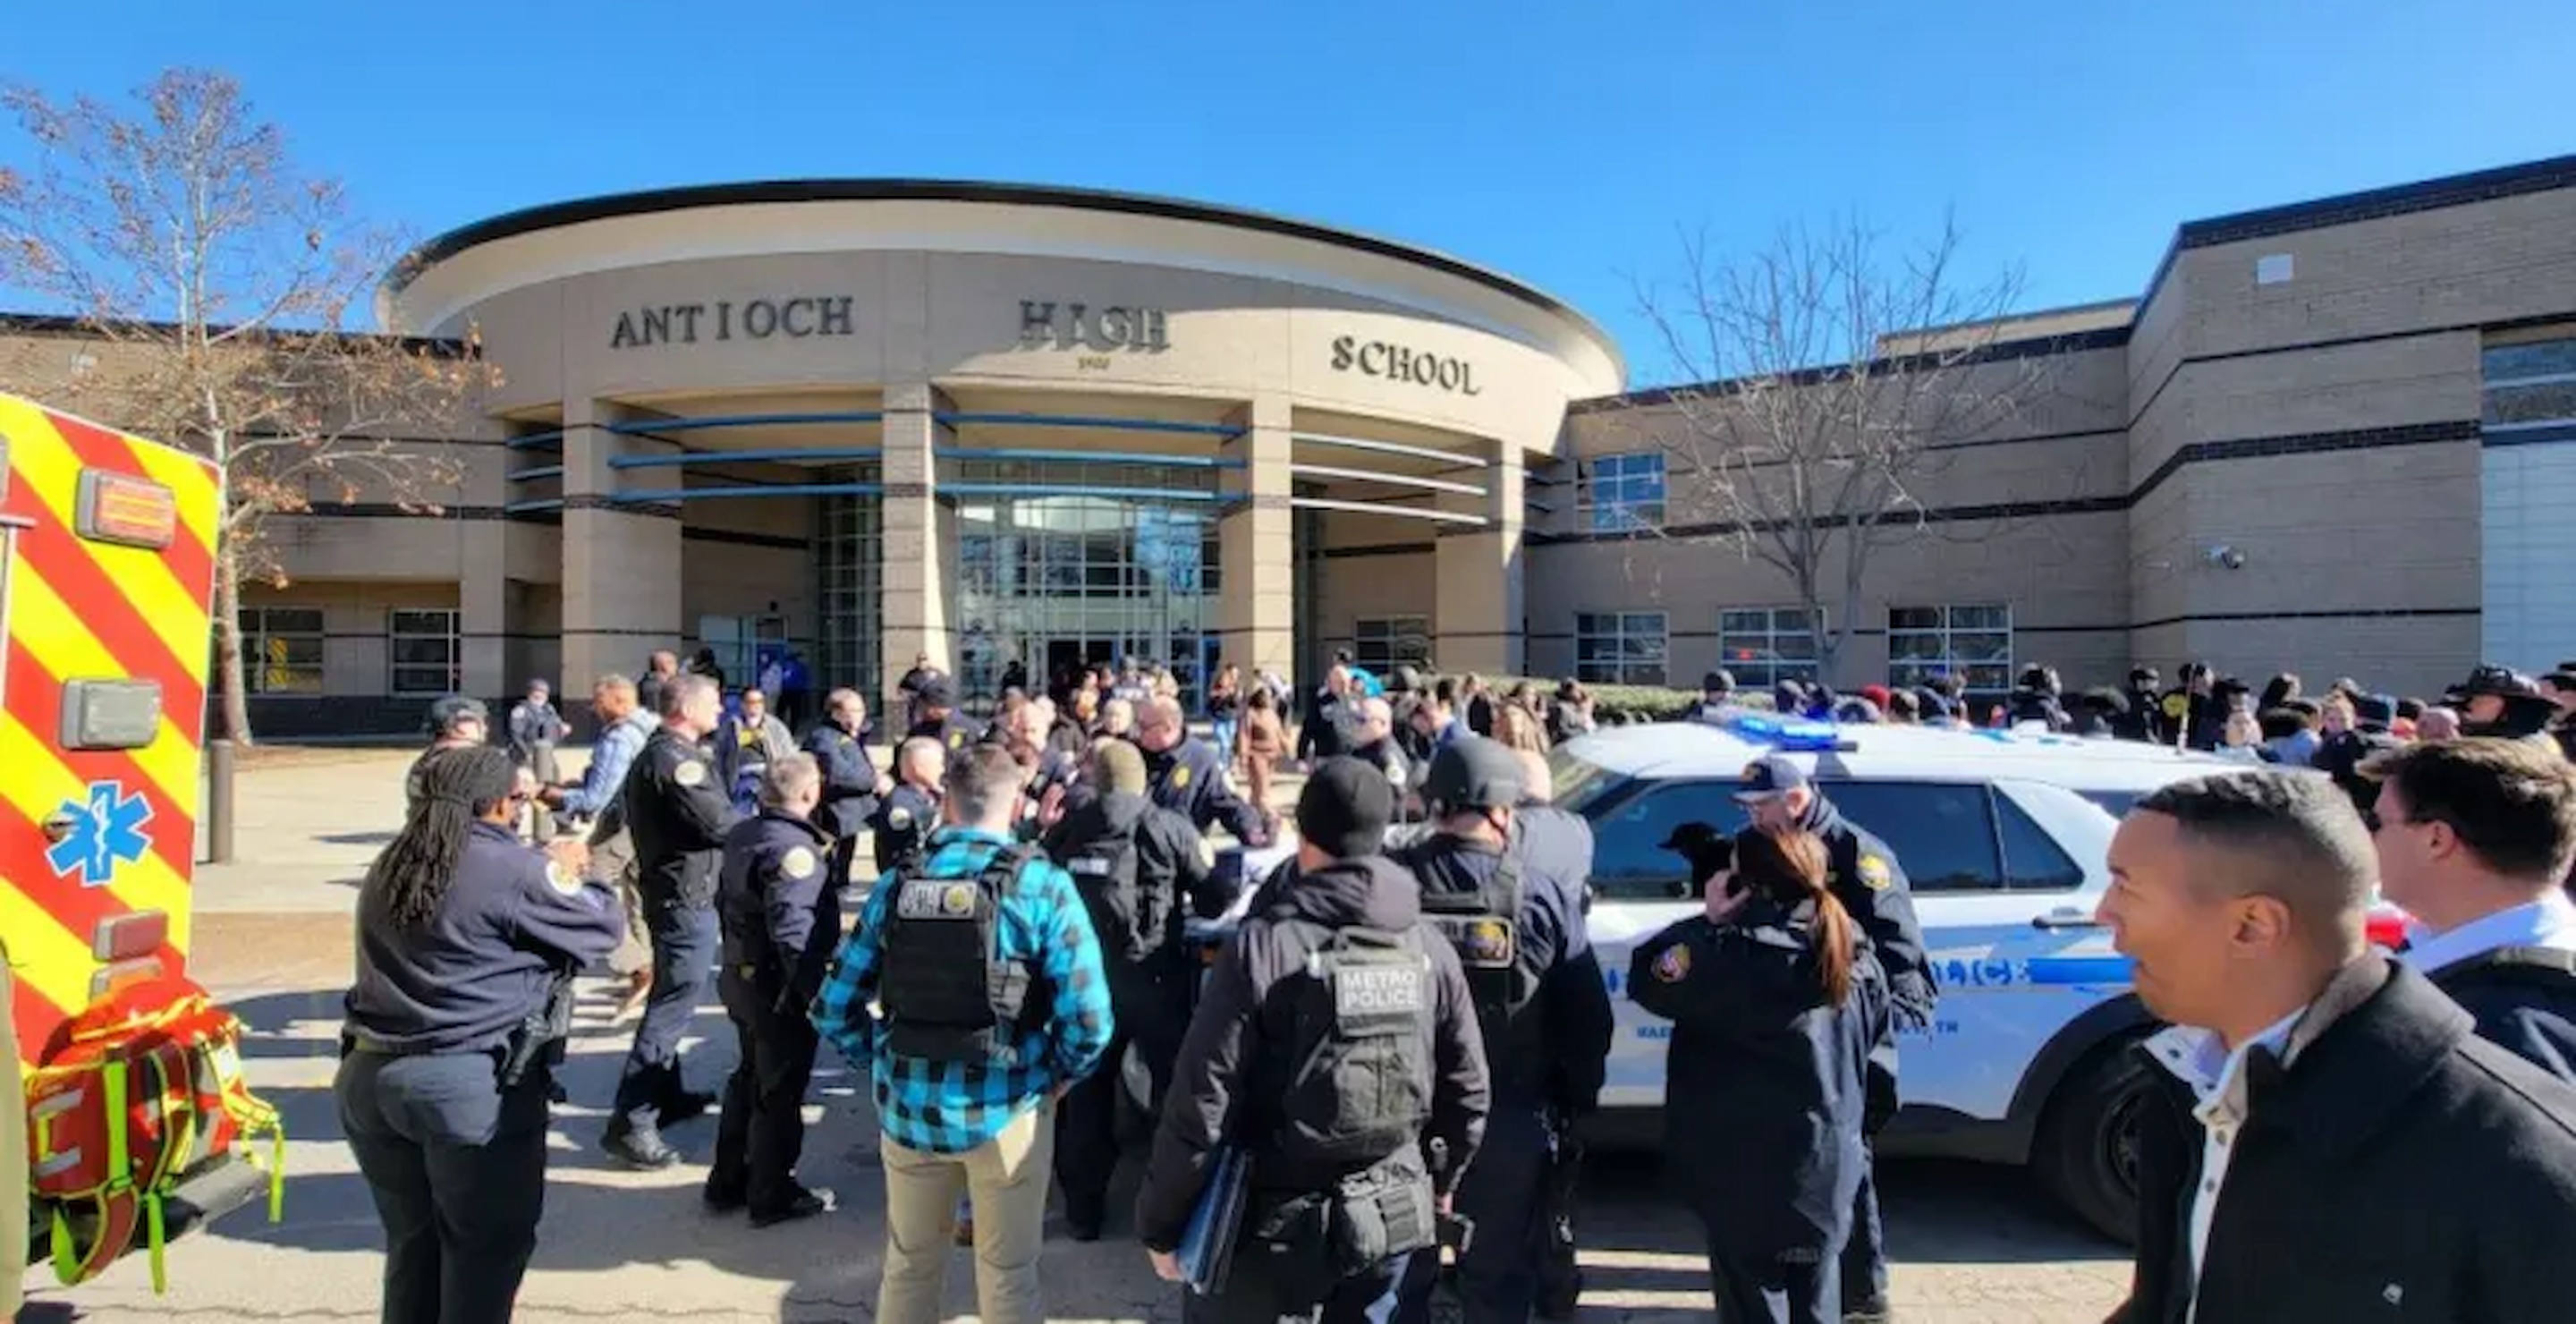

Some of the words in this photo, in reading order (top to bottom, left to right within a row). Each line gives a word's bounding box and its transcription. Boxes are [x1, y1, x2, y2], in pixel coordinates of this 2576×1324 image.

[609, 295, 853, 348] ANTIOCH
[1019, 301, 1171, 349] HIGH
[1331, 335, 1481, 396] SCHOOL
[1342, 969, 1417, 990] METRO
[1343, 987, 1419, 1008] POLICE
